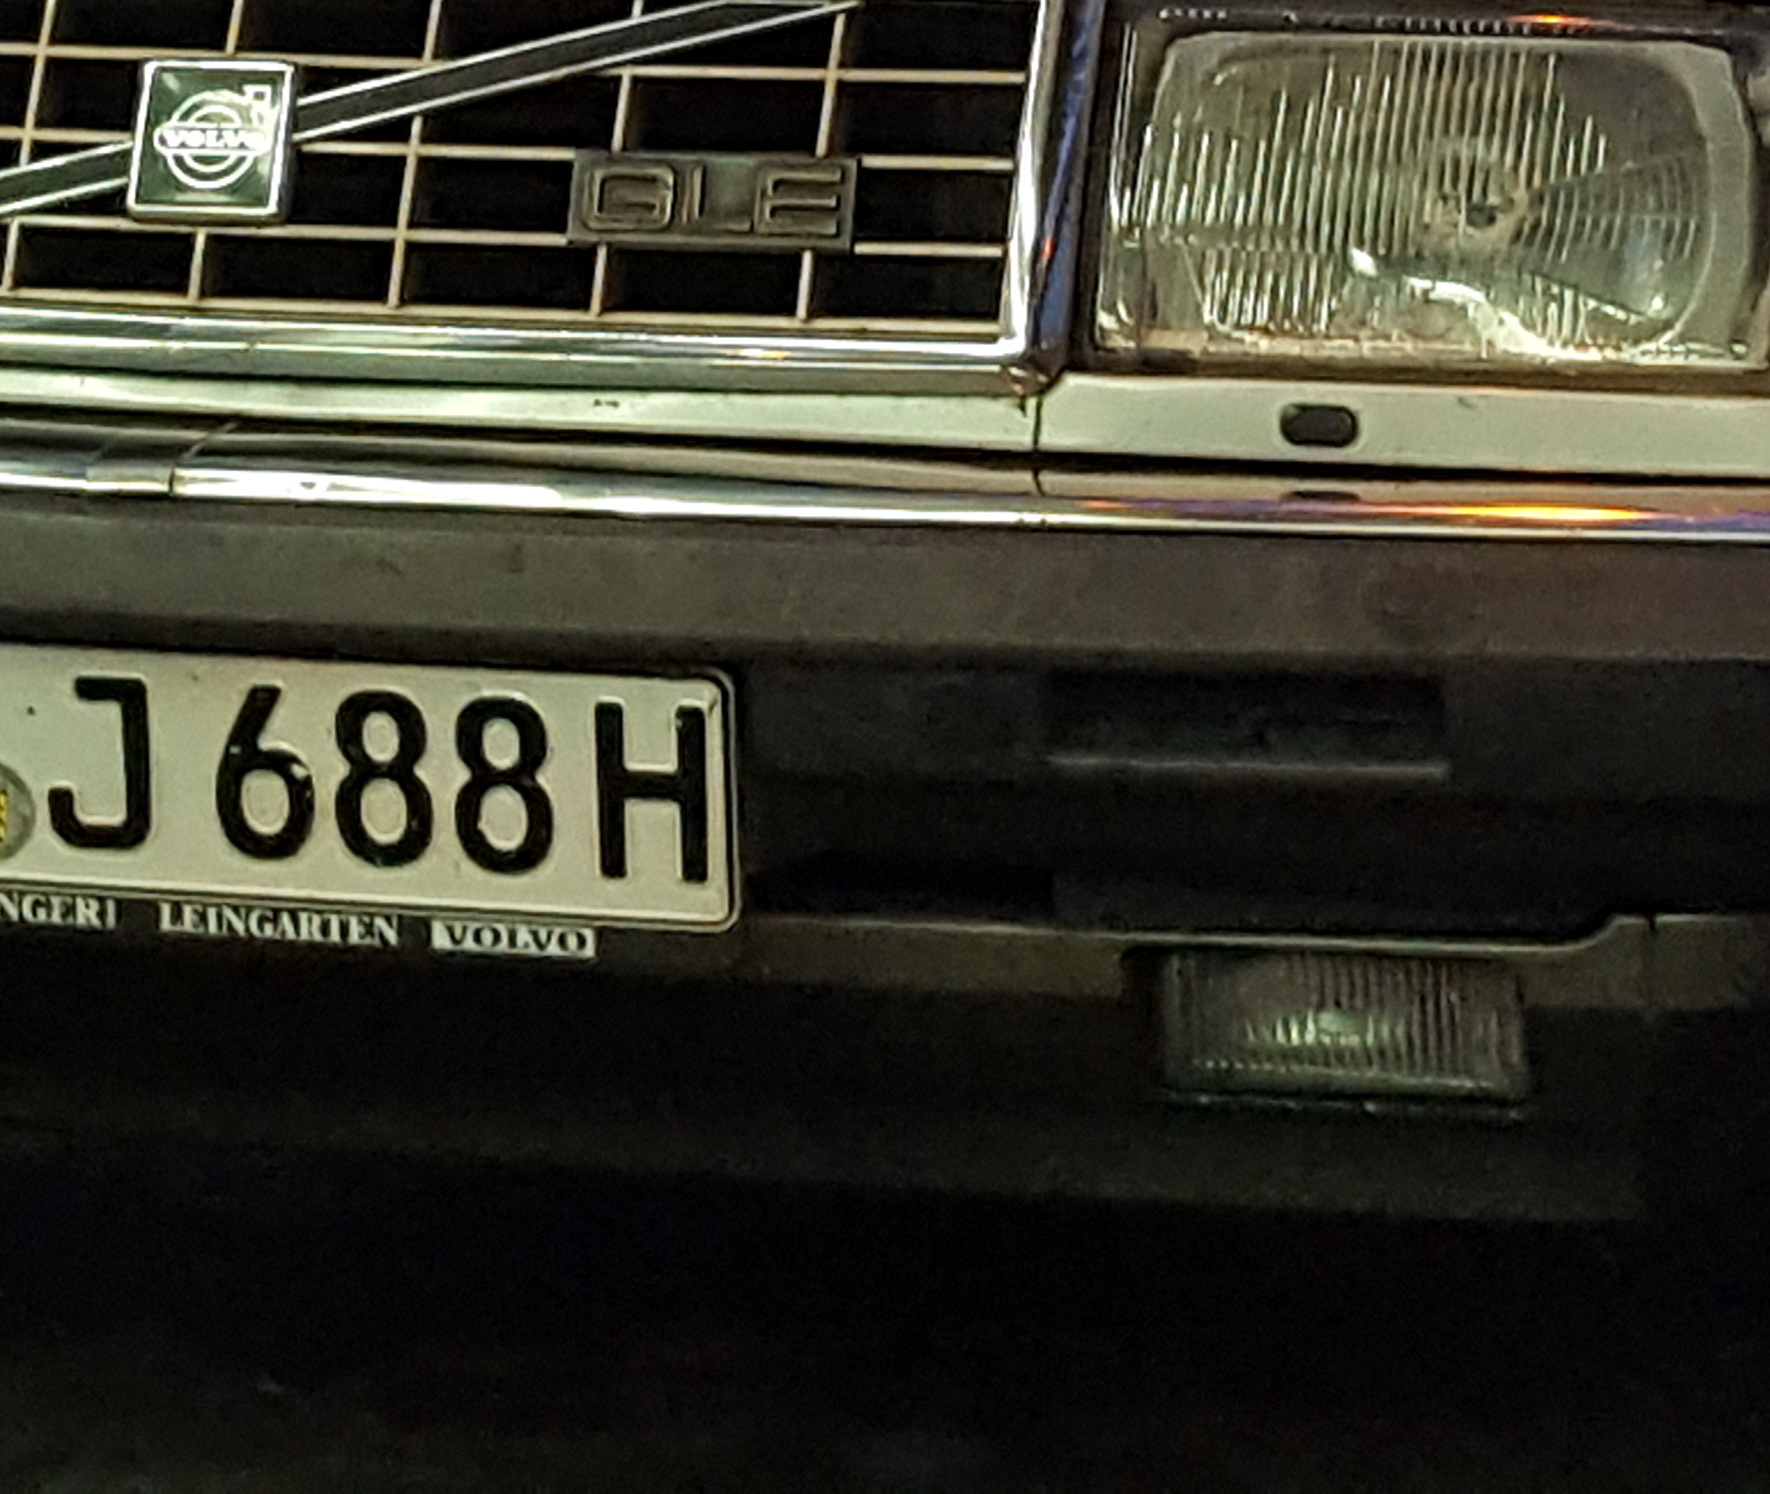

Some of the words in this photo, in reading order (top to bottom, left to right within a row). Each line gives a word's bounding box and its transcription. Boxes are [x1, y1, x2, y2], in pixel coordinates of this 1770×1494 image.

[159, 125, 269, 149] VOLVO
[582, 163, 843, 236] GLE
[46, 674, 152, 850] J
[215, 683, 709, 883] 688H
[160, 903, 399, 946] LEINGARTEN
[445, 924, 589, 954] VOLVO
